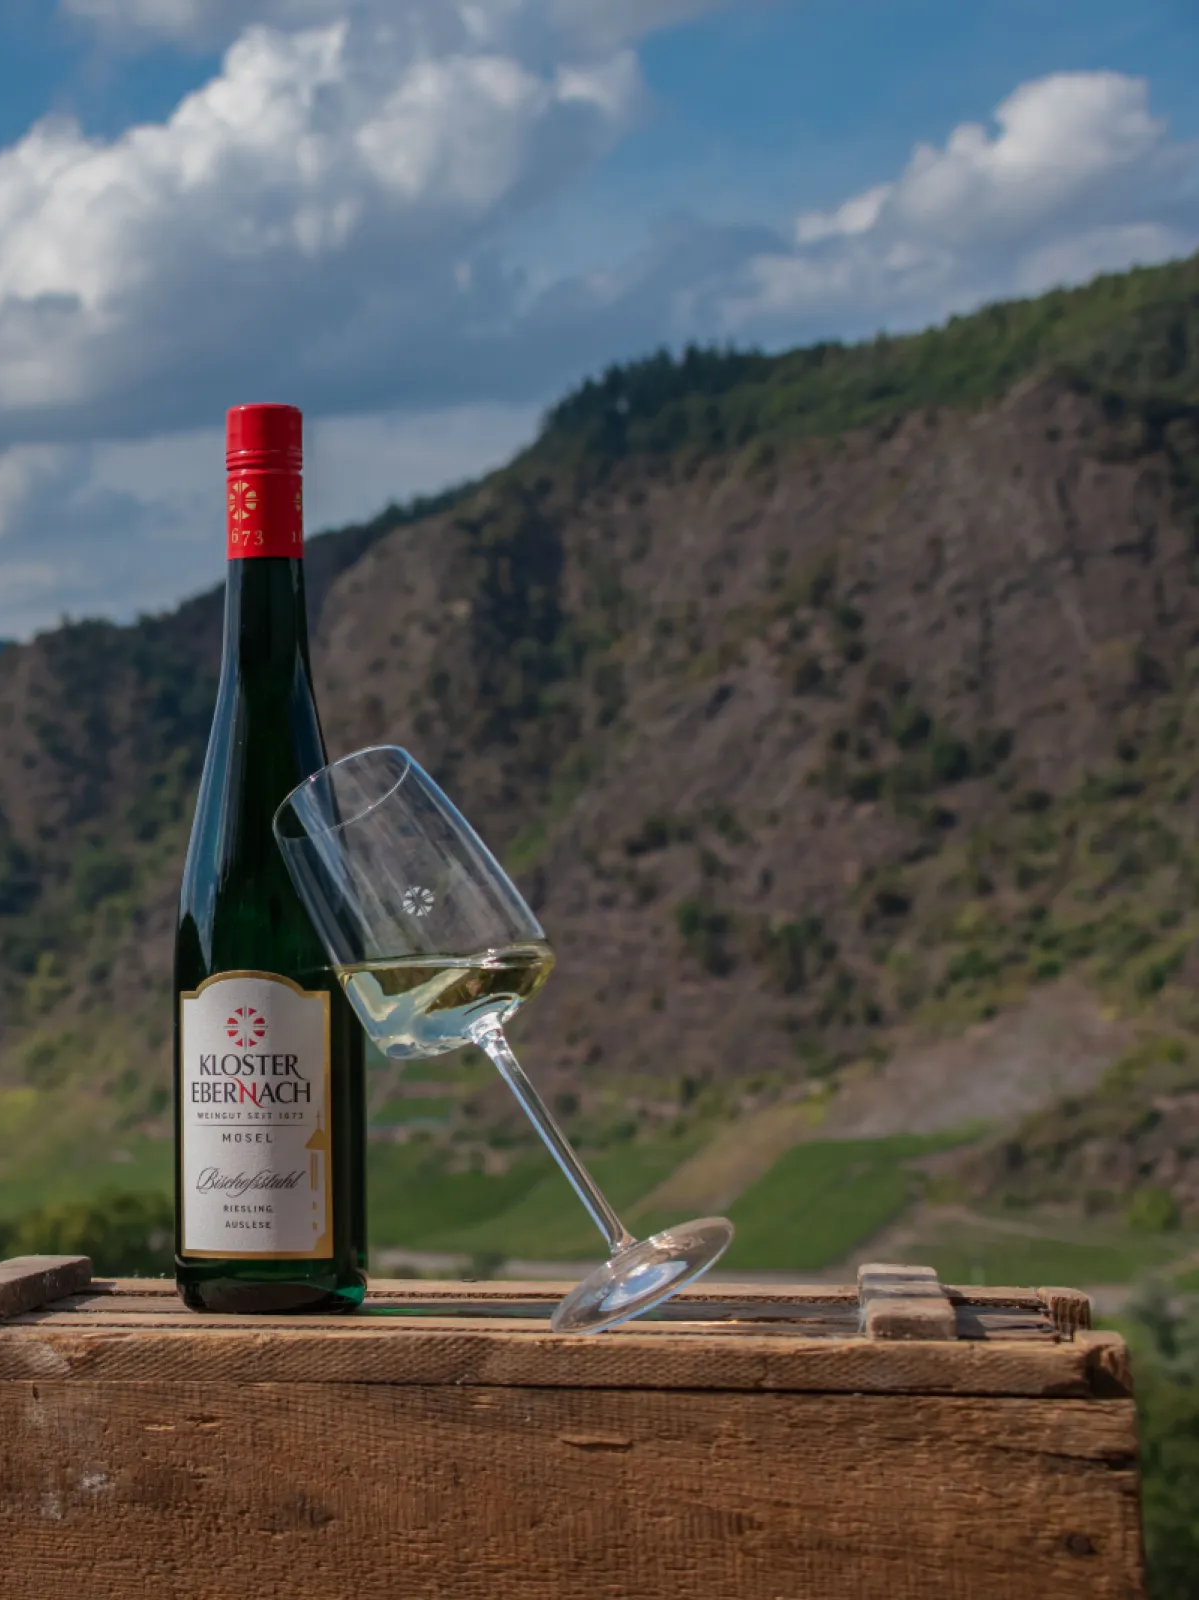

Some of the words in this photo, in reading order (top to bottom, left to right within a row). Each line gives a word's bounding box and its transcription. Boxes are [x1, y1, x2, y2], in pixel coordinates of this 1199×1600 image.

[199, 1054, 306, 1079] KLOSTER
[192, 1077, 311, 1107] EBERNACH
[195, 1111, 242, 1120] WEINGUT
[247, 1111, 273, 1120] SEIT
[222, 1133, 273, 1143] MOSEL
[223, 1204, 274, 1213] RIESLING
[225, 1220, 271, 1229] AUSLESE
